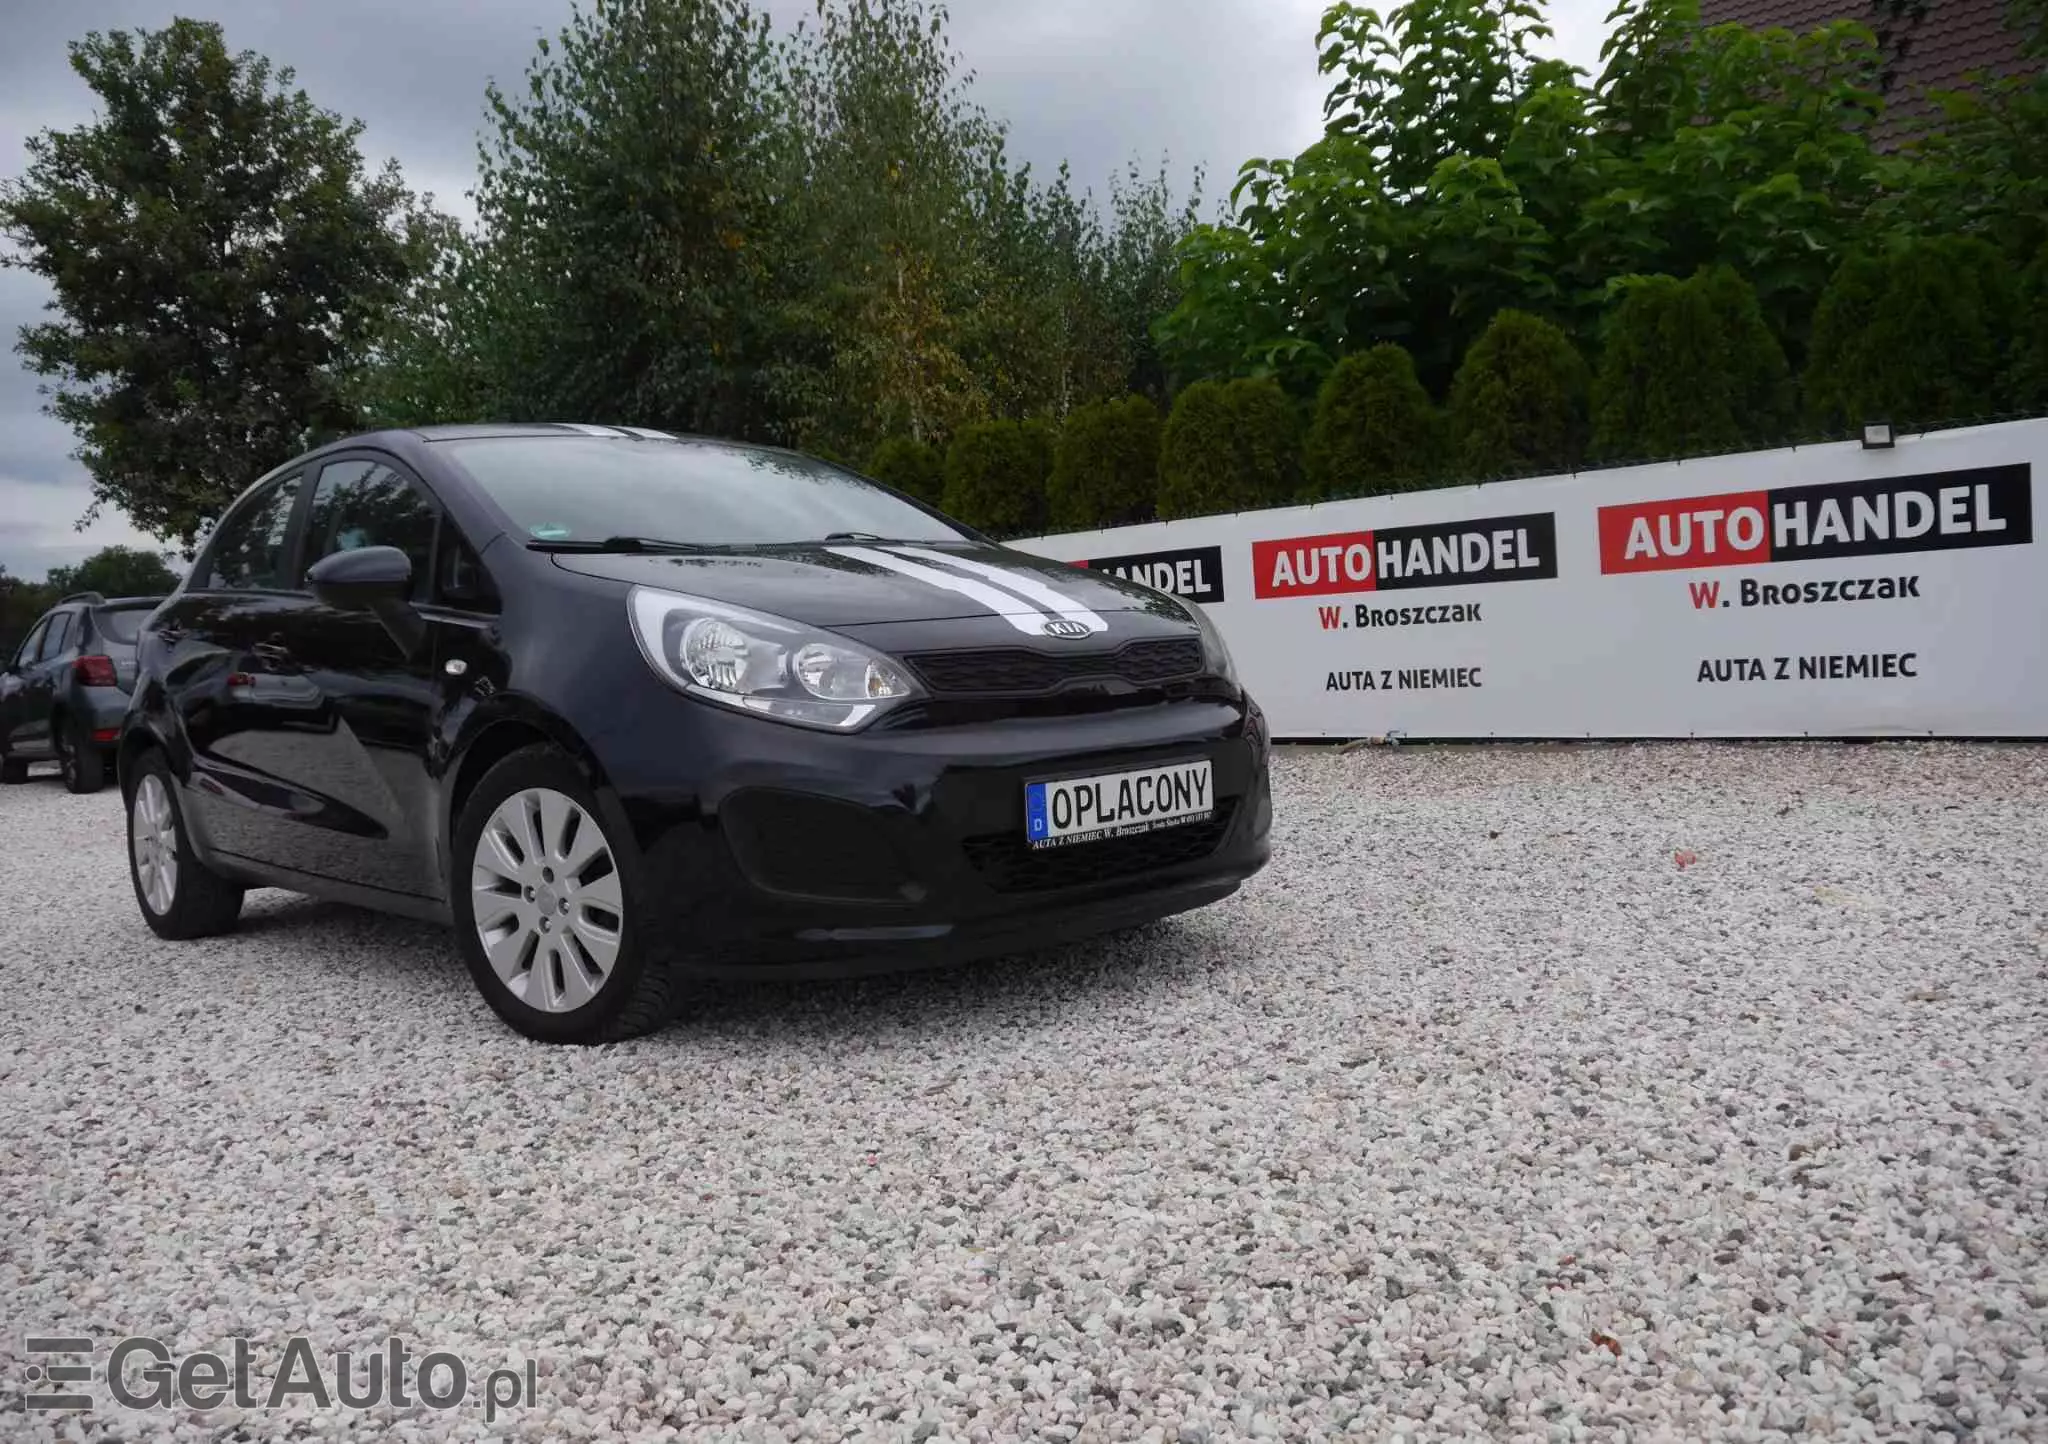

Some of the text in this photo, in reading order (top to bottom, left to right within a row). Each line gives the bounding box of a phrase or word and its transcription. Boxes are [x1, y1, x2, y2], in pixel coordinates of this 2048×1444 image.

[1624, 484, 2007, 561] AUTOHANDEL
[1272, 528, 1541, 588] AUTOHANDEL
[1689, 580, 1730, 610] W.
[1049, 622, 1088, 634] KIA
[1319, 606, 1348, 630] W.
[1326, 667, 1482, 691] AUTA Z NIEMIEC
[1697, 652, 1917, 683] AUTA Z NIEMIEC
[1052, 767, 1207, 830] OPLACONY
